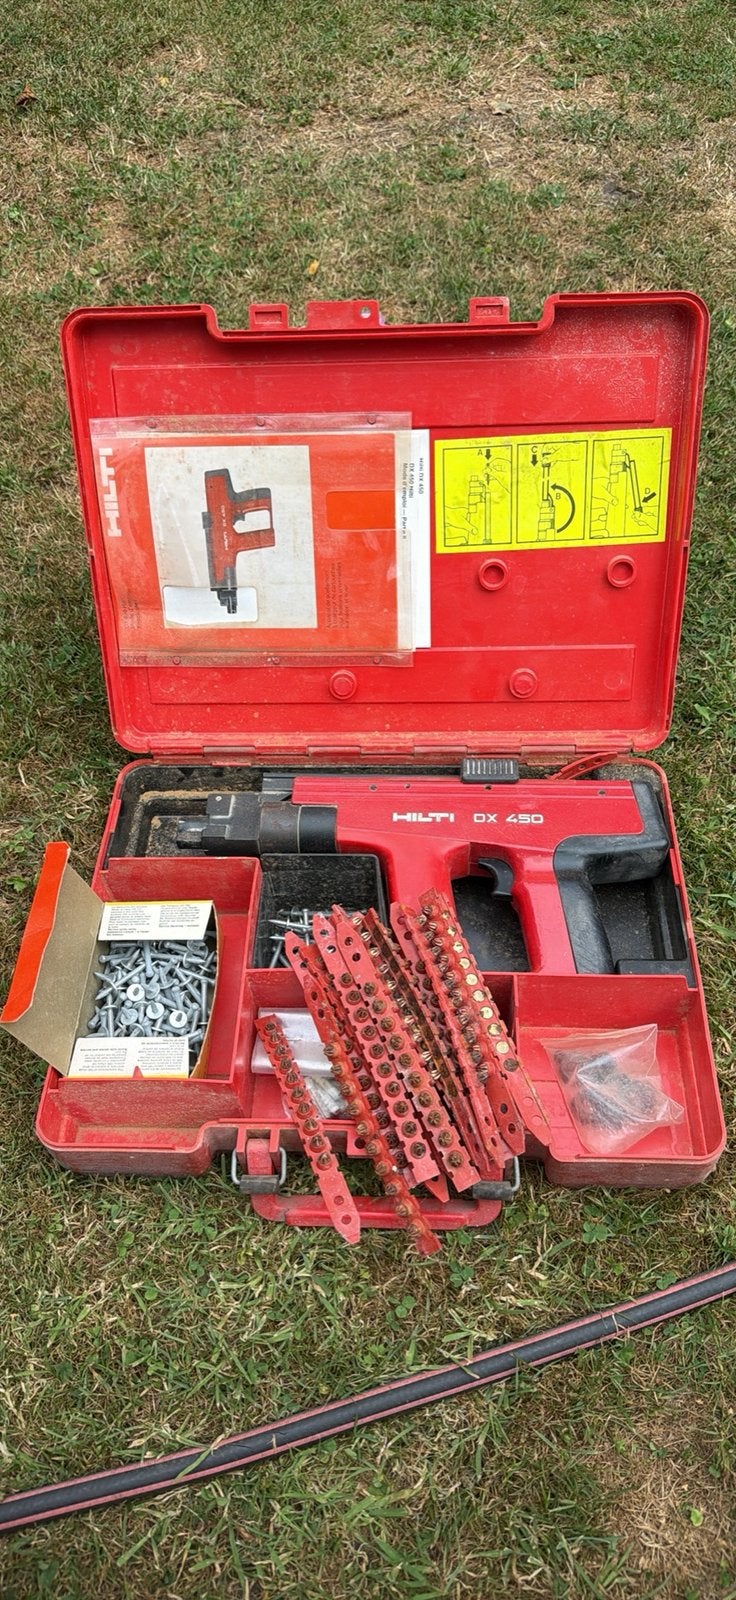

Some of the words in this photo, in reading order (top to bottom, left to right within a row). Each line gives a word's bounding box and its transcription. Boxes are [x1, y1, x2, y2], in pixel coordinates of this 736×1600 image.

[477, 448, 484, 456] A
[531, 445, 538, 454] C
[98, 447, 122, 537] HILTI
[555, 492, 561, 500] B
[392, 812, 455, 823] HILTI
[473, 813, 498, 824] DX
[506, 813, 544, 825] 450
